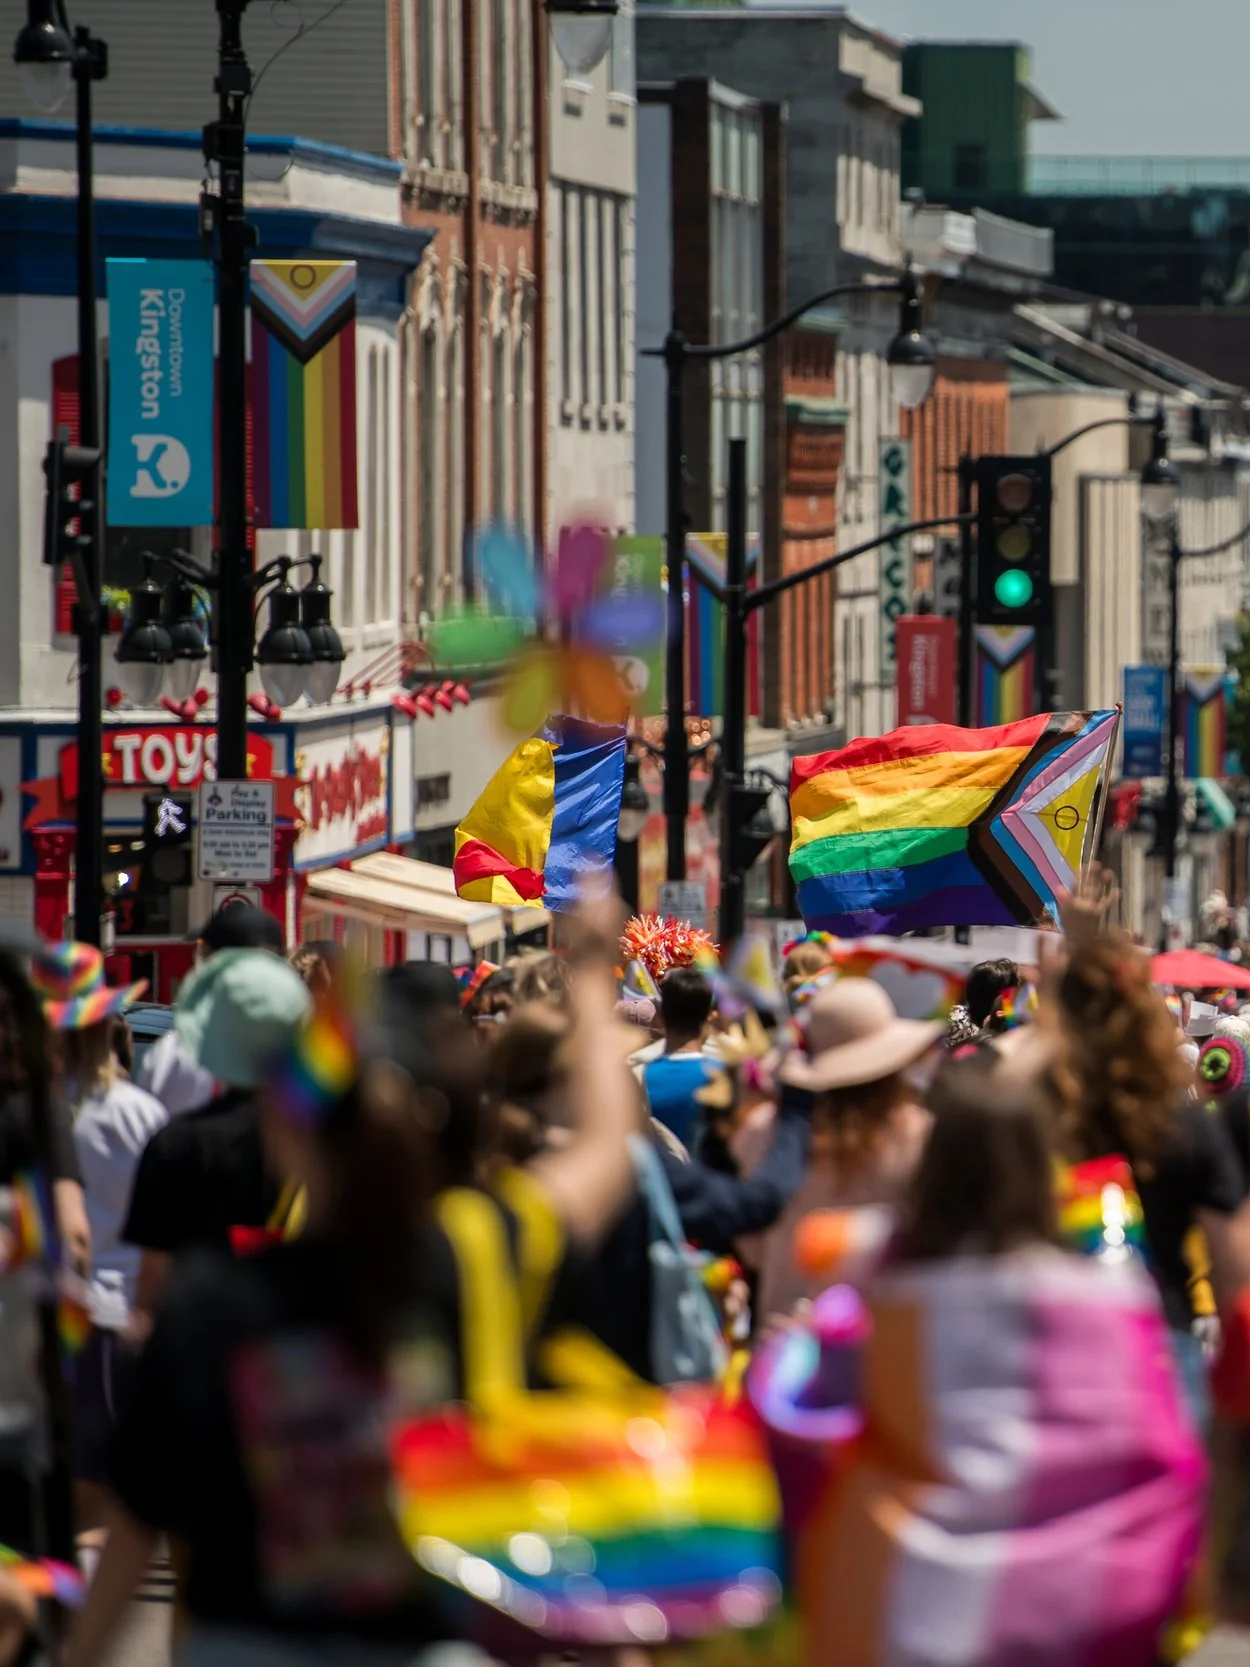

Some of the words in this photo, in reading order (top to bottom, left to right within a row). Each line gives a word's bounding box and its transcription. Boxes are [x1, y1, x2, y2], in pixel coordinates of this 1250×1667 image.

[136, 289, 165, 419] Kingston
[168, 289, 185, 397] Downtown
[611, 554, 631, 647] Kingn
[206, 808, 267, 825] Parking
[231, 799, 267, 809] Display
